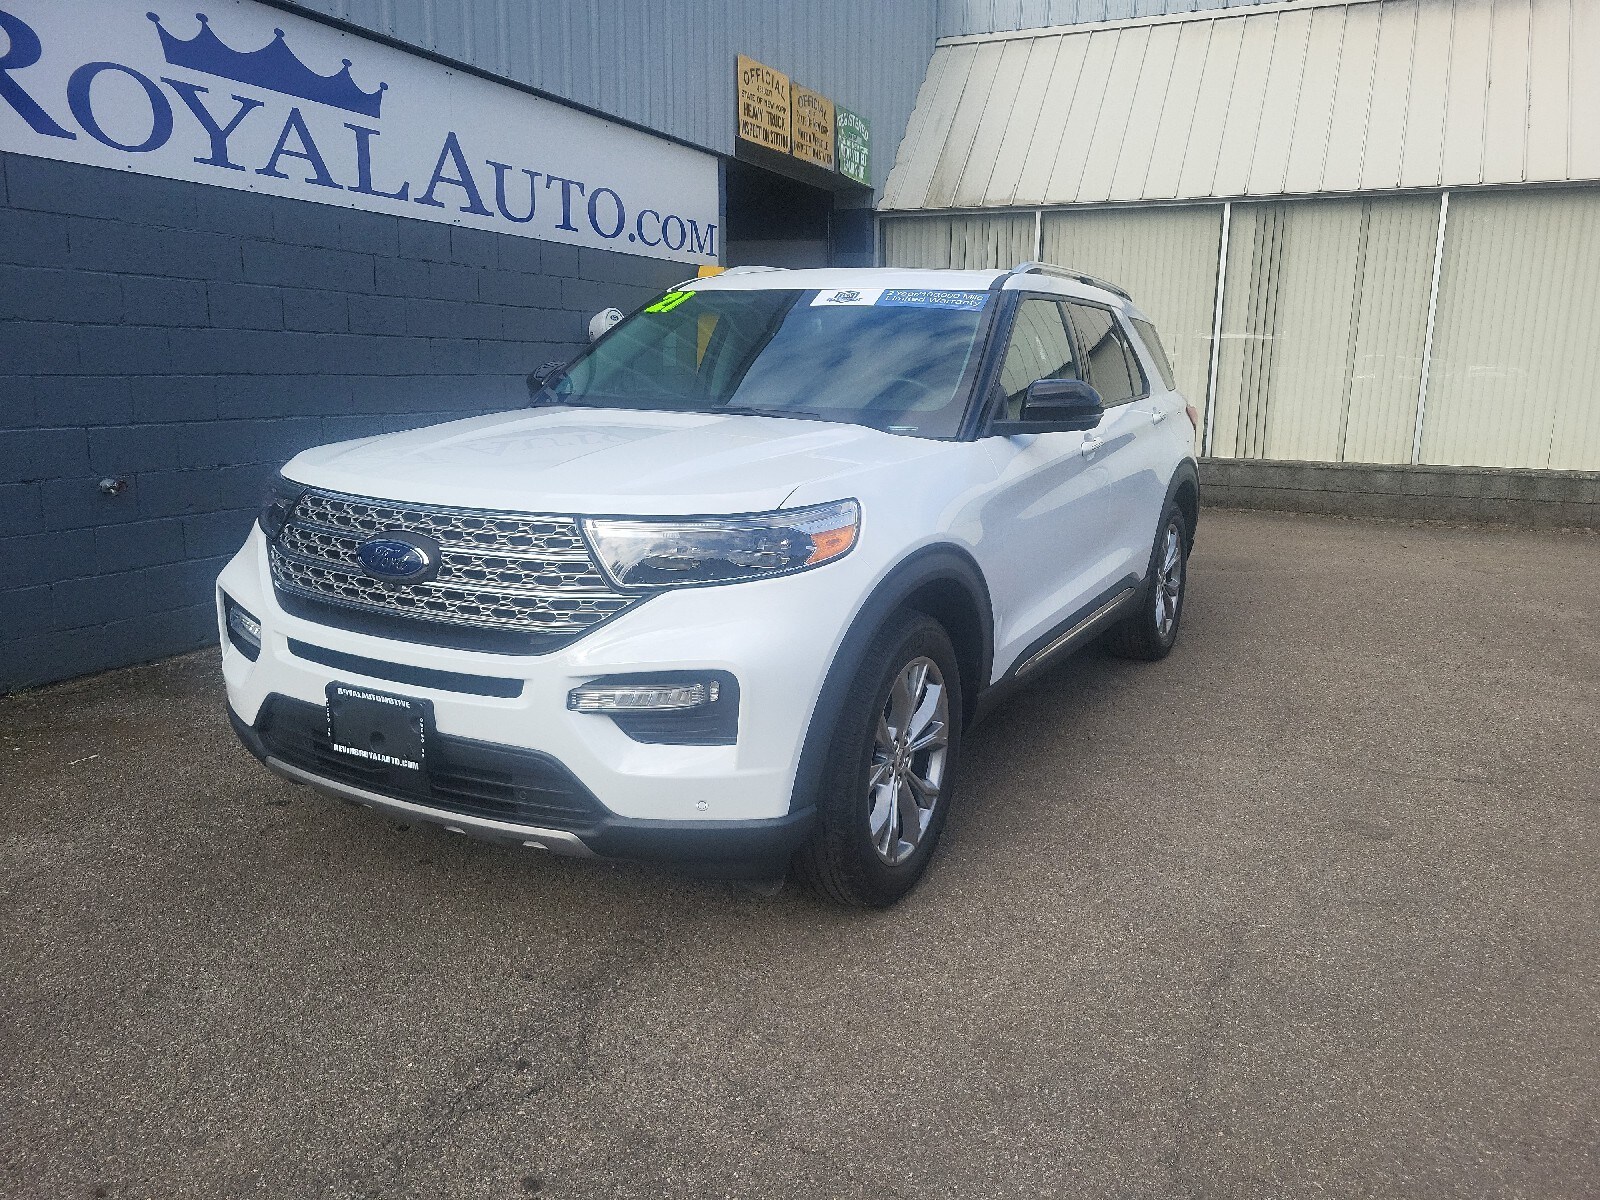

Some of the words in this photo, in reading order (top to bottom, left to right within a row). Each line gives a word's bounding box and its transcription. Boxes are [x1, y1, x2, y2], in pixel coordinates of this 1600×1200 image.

[743, 67, 786, 102] OFFICIAL
[743, 101, 764, 122] HEAVY
[766, 110, 786, 131] TRUCK
[797, 94, 828, 124] OFFICIAL
[740, 118, 770, 143] INSPECTION
[928, 297, 982, 307] Warranty
